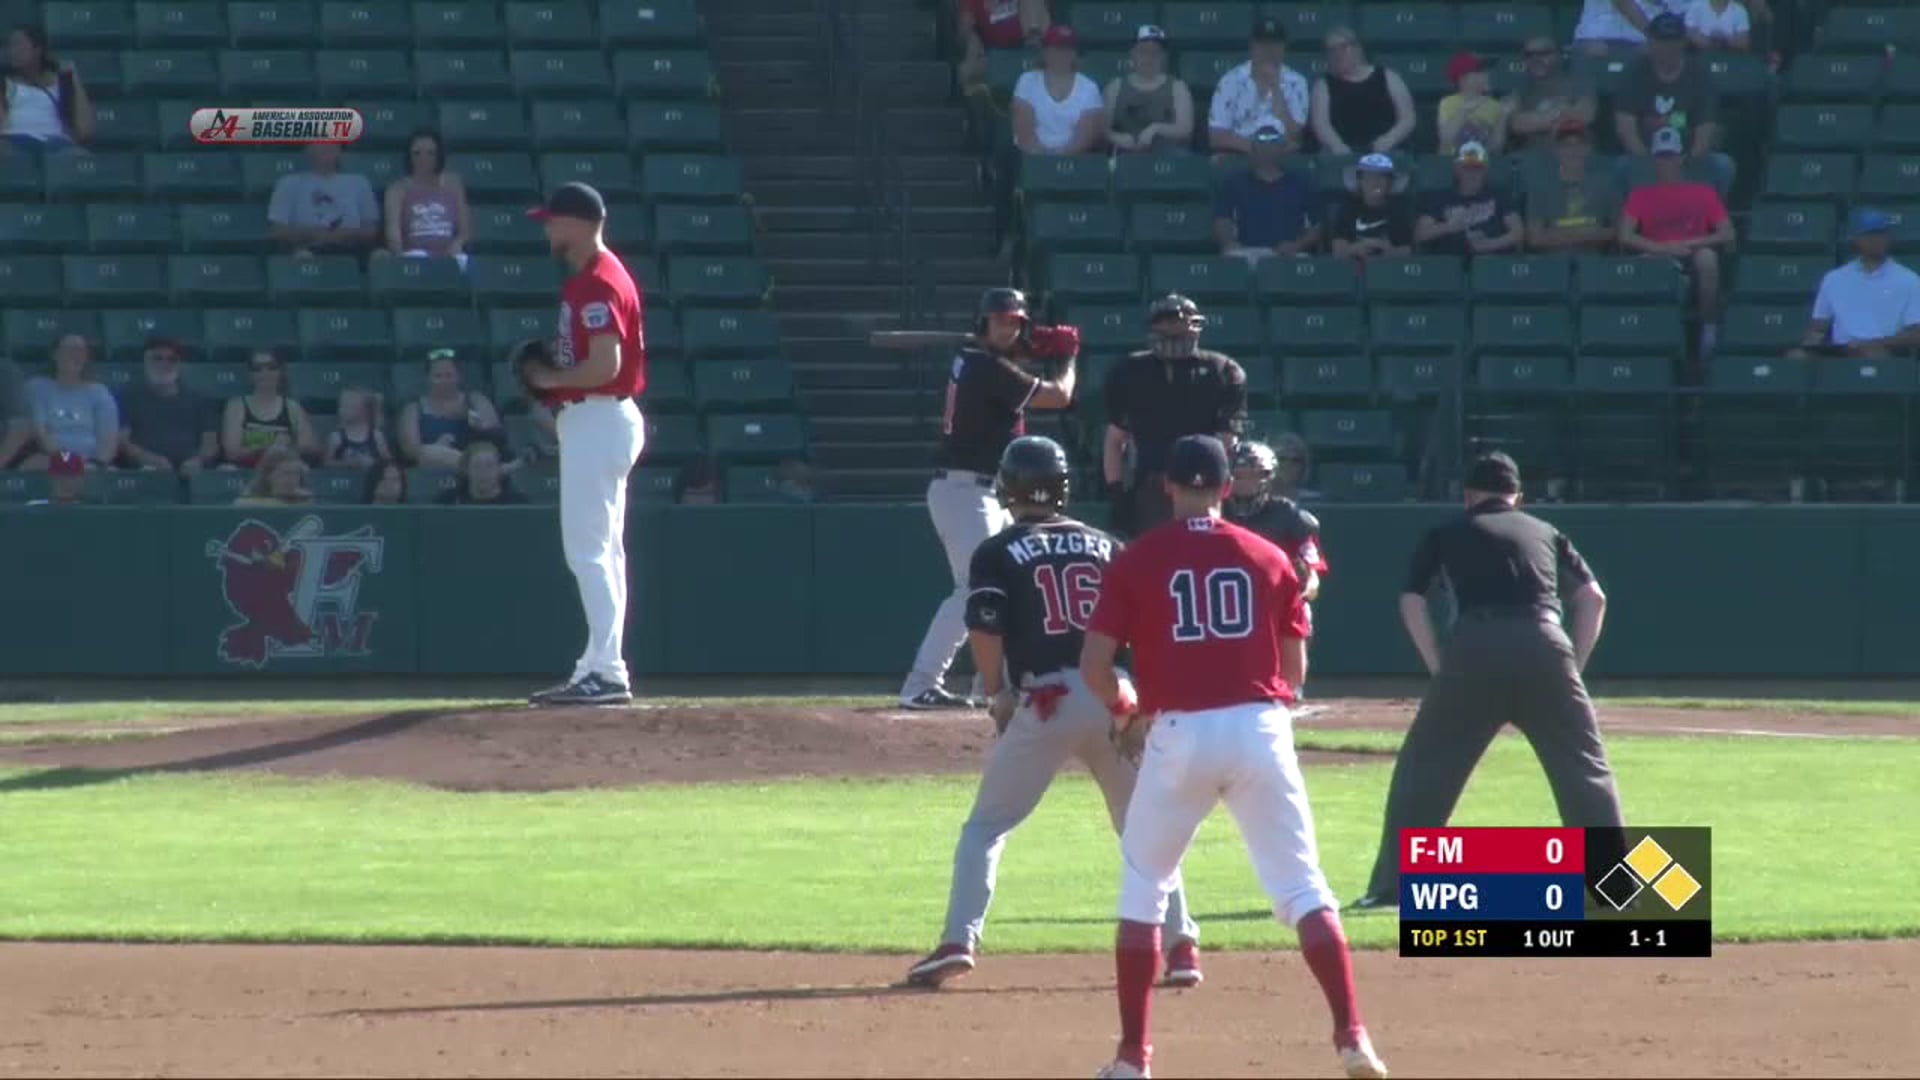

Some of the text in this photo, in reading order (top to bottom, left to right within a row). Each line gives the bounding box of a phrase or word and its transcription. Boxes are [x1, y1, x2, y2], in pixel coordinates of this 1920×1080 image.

[1007, 533, 1113, 565] METZGER
[1034, 562, 1101, 635] 16
[1169, 568, 1253, 642] 10
